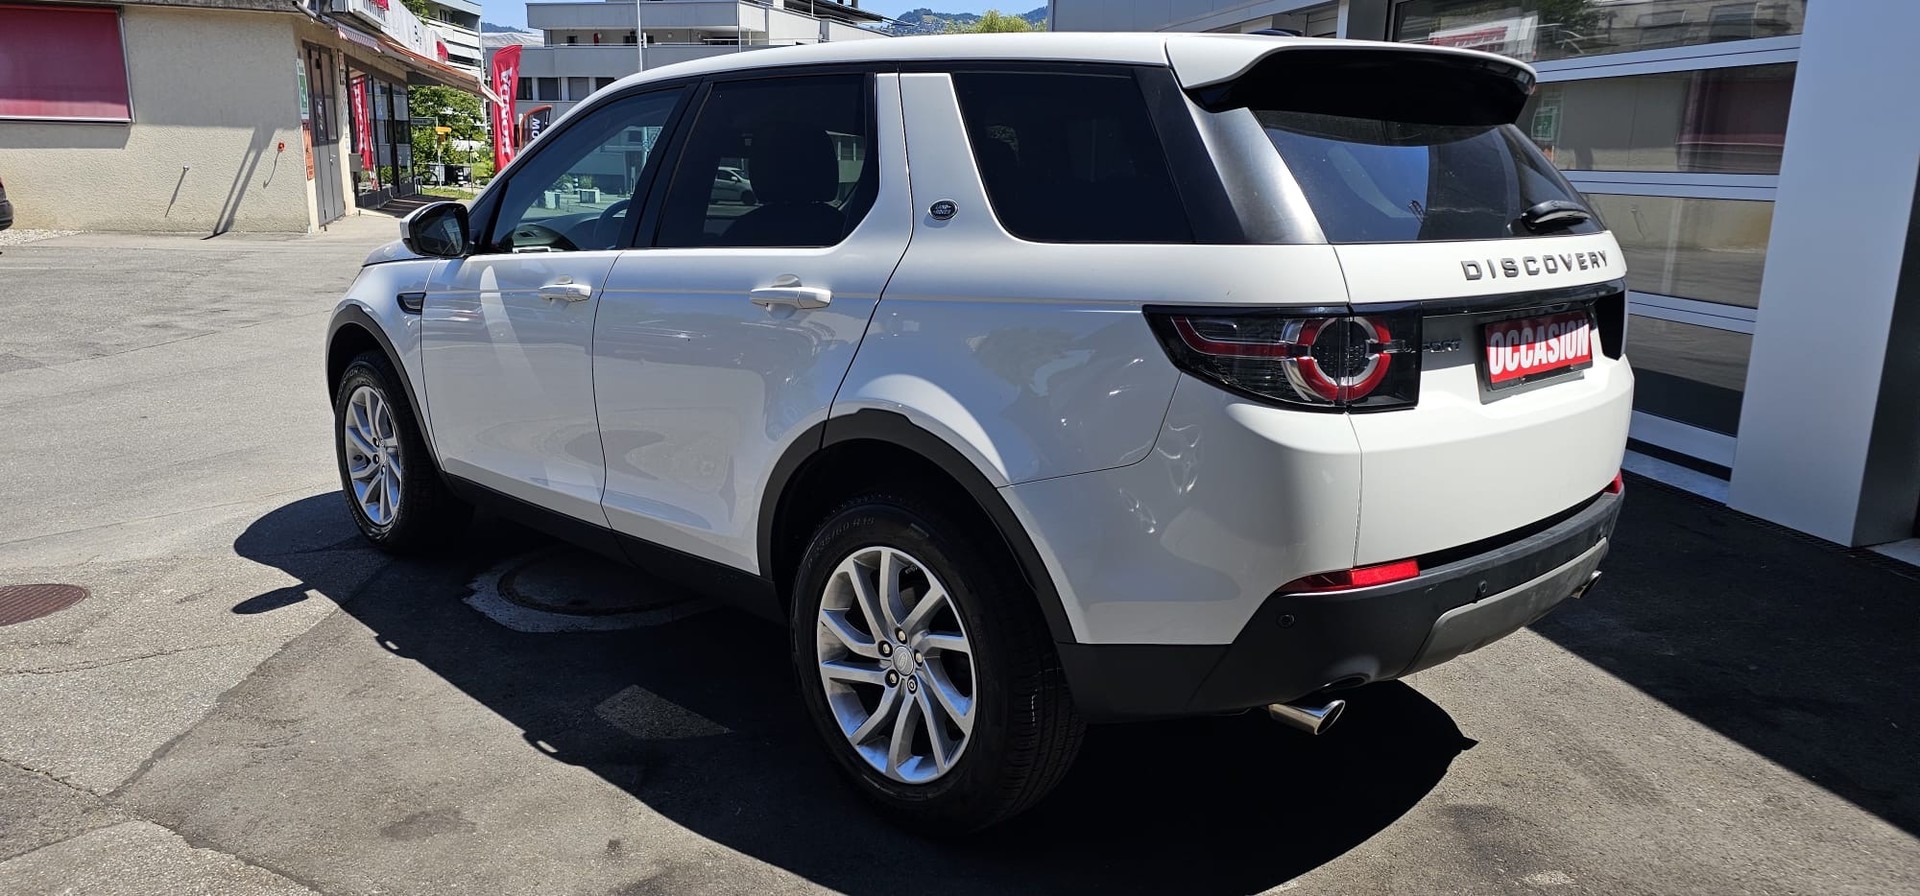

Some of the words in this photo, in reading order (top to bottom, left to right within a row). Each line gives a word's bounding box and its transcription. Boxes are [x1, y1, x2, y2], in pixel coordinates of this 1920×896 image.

[500, 67, 513, 155] HONDA
[1461, 250, 1608, 281] DISCOVERY
[1489, 318, 1590, 375] OCCASION
